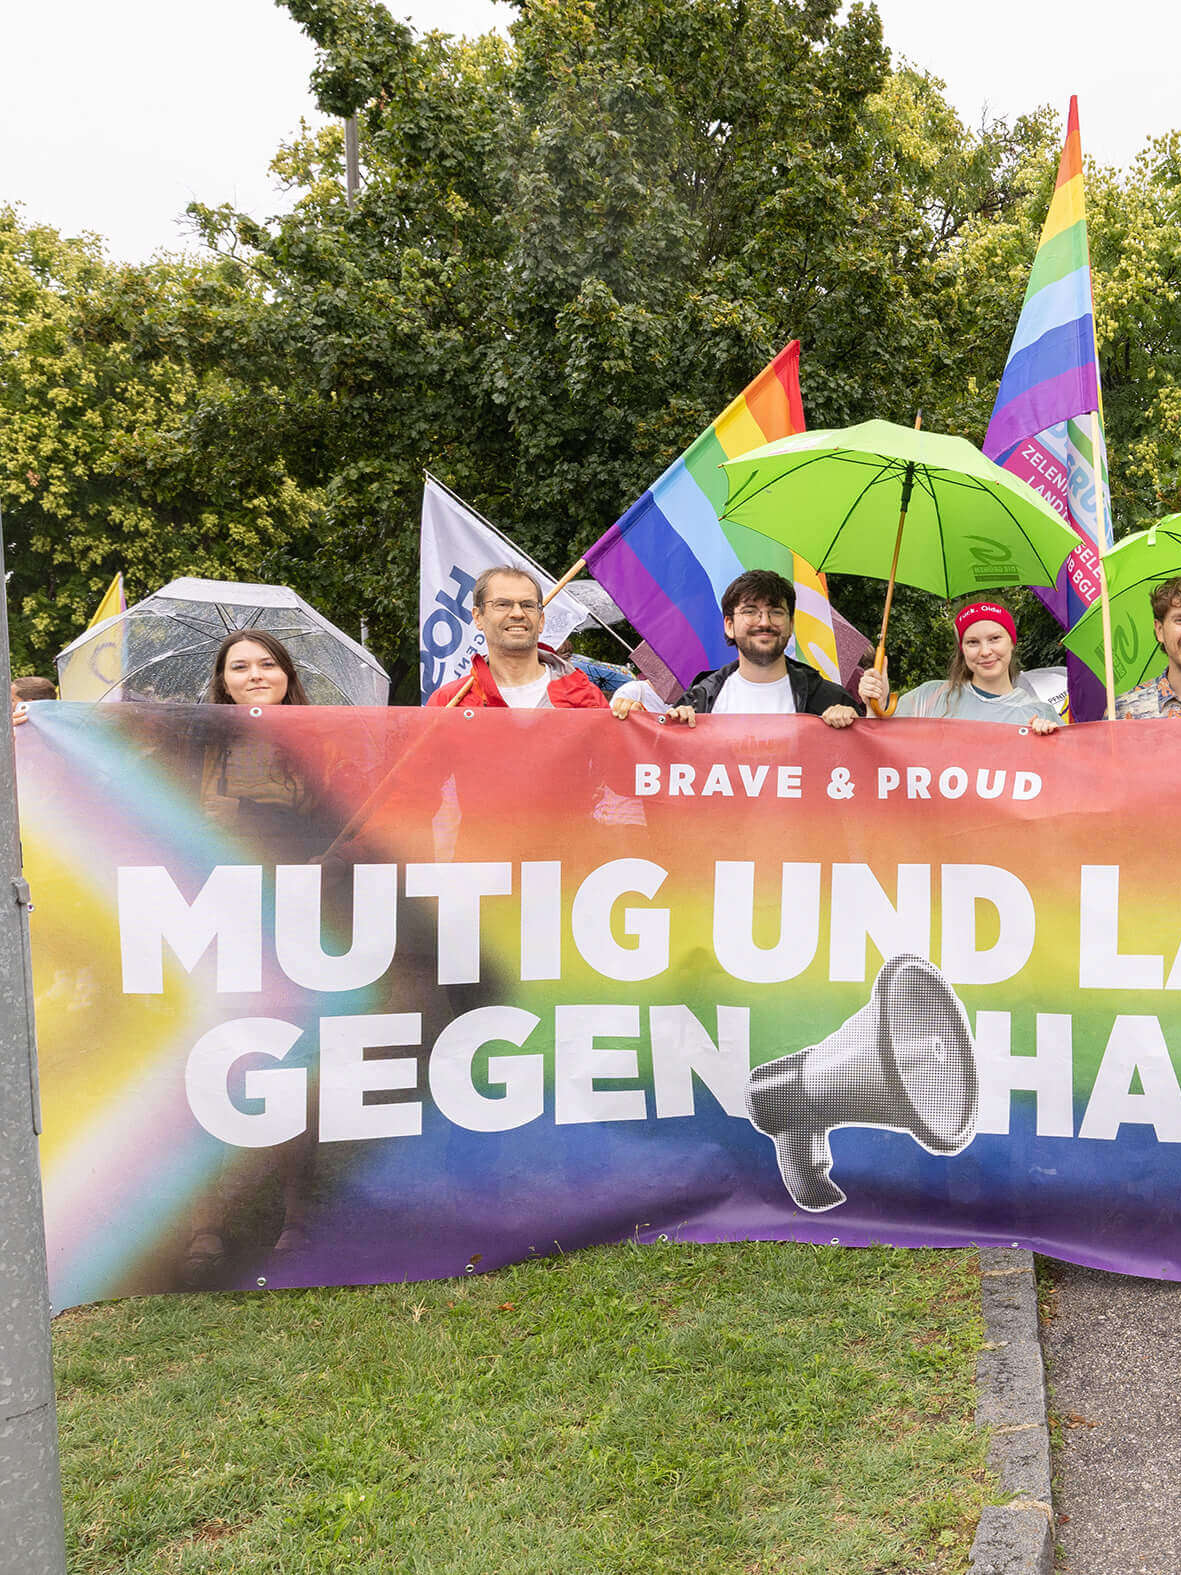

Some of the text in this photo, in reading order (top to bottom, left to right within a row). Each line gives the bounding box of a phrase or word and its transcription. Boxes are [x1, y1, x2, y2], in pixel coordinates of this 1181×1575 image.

[635, 763, 1043, 801] BRAVE & PROUD
[117, 857, 671, 994] MUTIG
[712, 860, 1036, 984] UND
[185, 1004, 750, 1148] GEGEN
